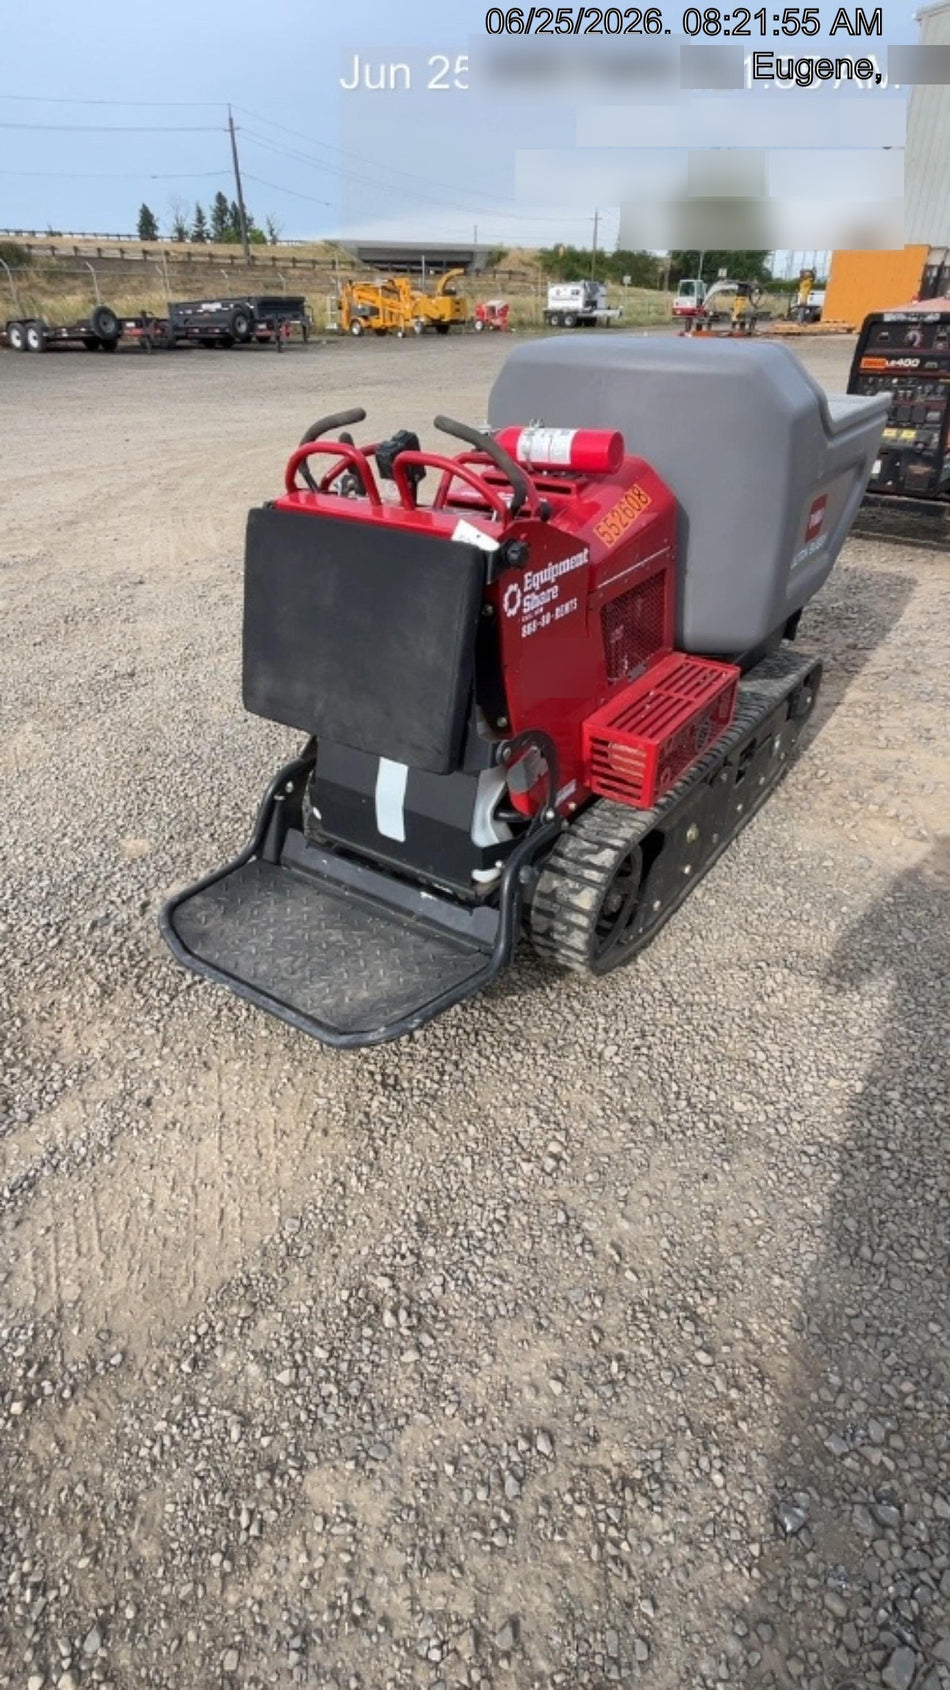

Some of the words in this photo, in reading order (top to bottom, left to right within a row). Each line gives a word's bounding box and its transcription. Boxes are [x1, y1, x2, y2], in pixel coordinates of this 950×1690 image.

[595, 486, 649, 545] 552608
[523, 547, 589, 592] Equipment
[522, 585, 559, 614] Share
